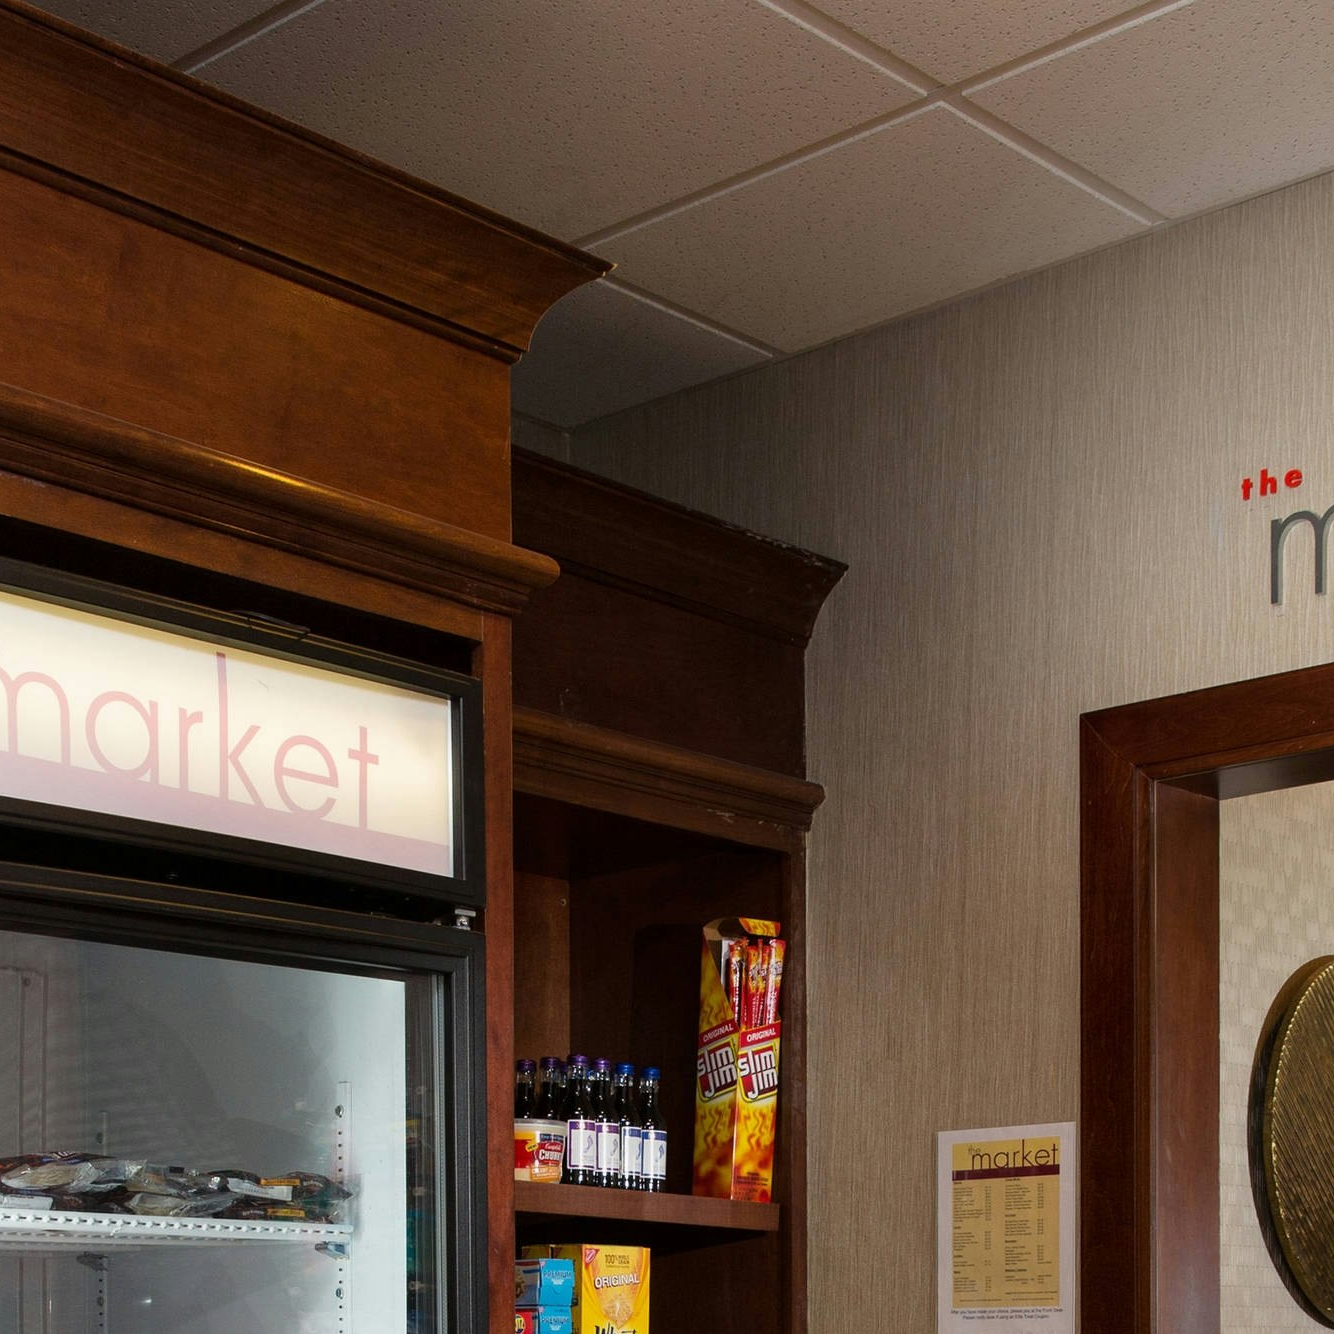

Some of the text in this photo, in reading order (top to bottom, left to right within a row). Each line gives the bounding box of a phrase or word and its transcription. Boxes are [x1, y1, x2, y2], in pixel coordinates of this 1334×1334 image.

[1241, 469, 1303, 501] the
[702, 1024, 734, 1043] ORIGINAL
[746, 1029, 776, 1043] ORIGINAL
[972, 1139, 1059, 1170] market
[543, 1272, 571, 1280] PREMIUM
[594, 1274, 641, 1289] ORIGINAL
[541, 1316, 569, 1325] PREMIUM
